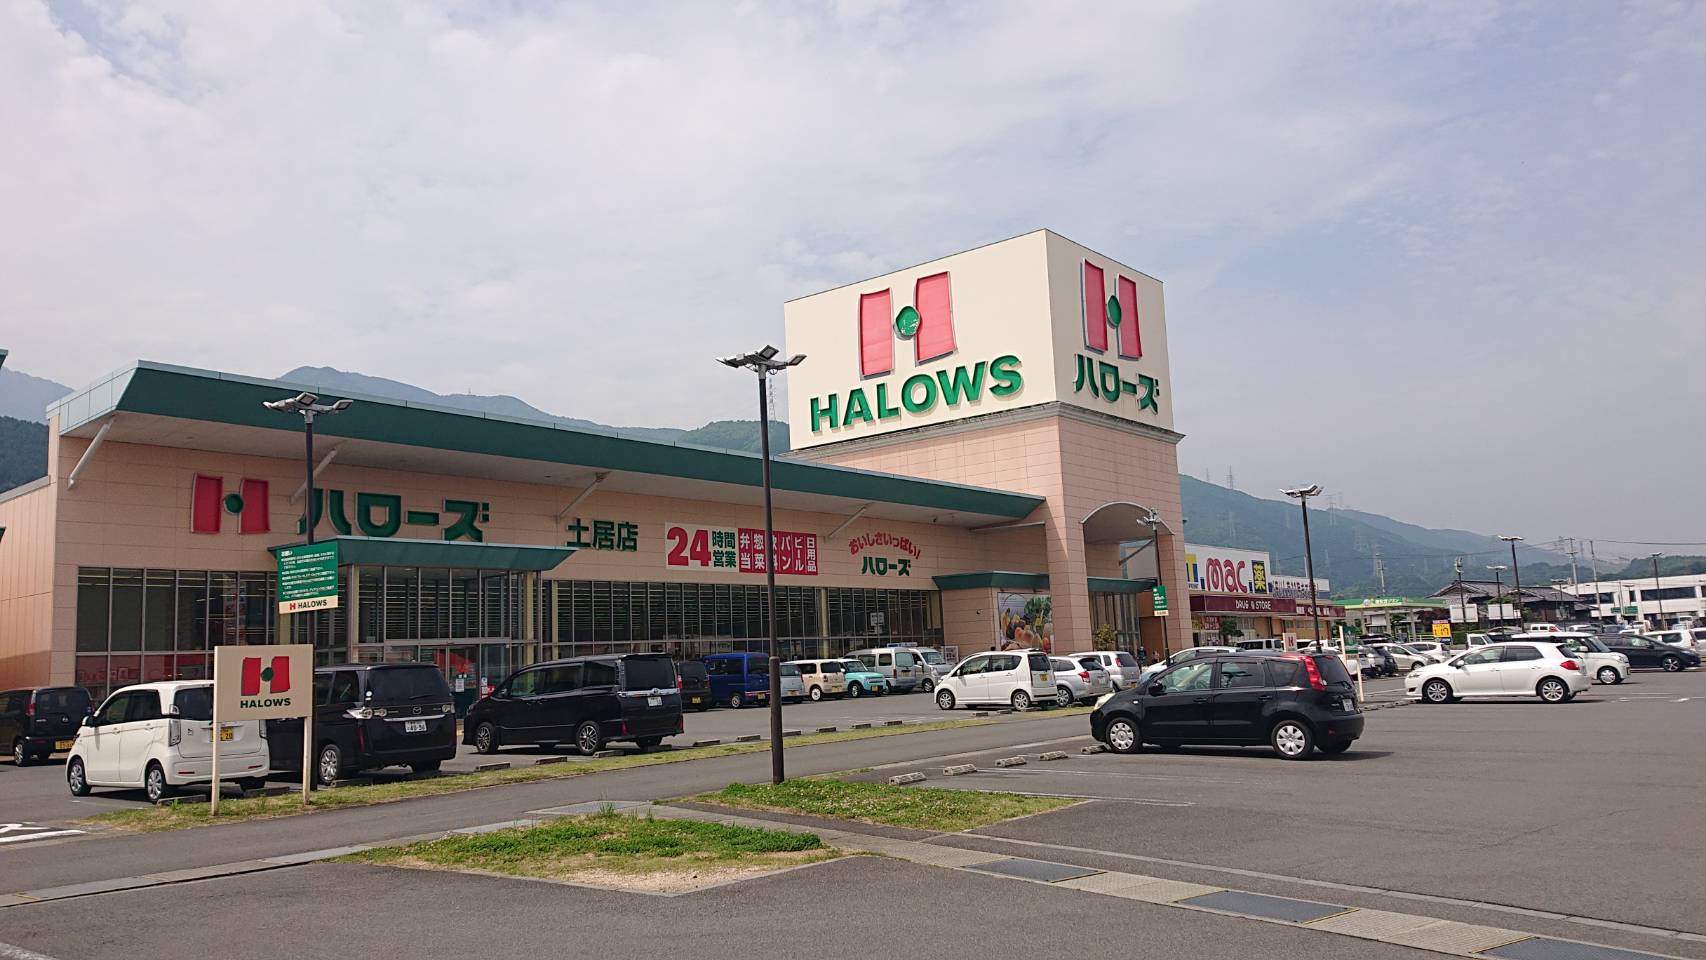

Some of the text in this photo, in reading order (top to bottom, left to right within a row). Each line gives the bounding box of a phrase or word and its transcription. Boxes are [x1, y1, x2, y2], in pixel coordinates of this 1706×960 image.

[809, 355, 1023, 433] HALOWS
[1073, 353, 1161, 415] ハローズ
[297, 487, 491, 543] ハローズ
[566, 517, 640, 553] 土居店
[666, 526, 711, 567] 24
[712, 530, 736, 549] 時間
[740, 533, 751, 570] 弁当
[712, 550, 737, 568] 営業
[754, 534, 766, 572] 惣菜
[794, 537, 805, 571] ビール
[806, 538, 817, 572] 日用品
[862, 556, 911, 577] ハローズ
[1206, 557, 1249, 593] mac
[1252, 563, 1266, 590] 薬
[297, 599, 328, 609] HALOWS
[1235, 600, 1249, 609] DRUG
[1255, 600, 1272, 610] STORE
[240, 698, 292, 709] HALOWS
